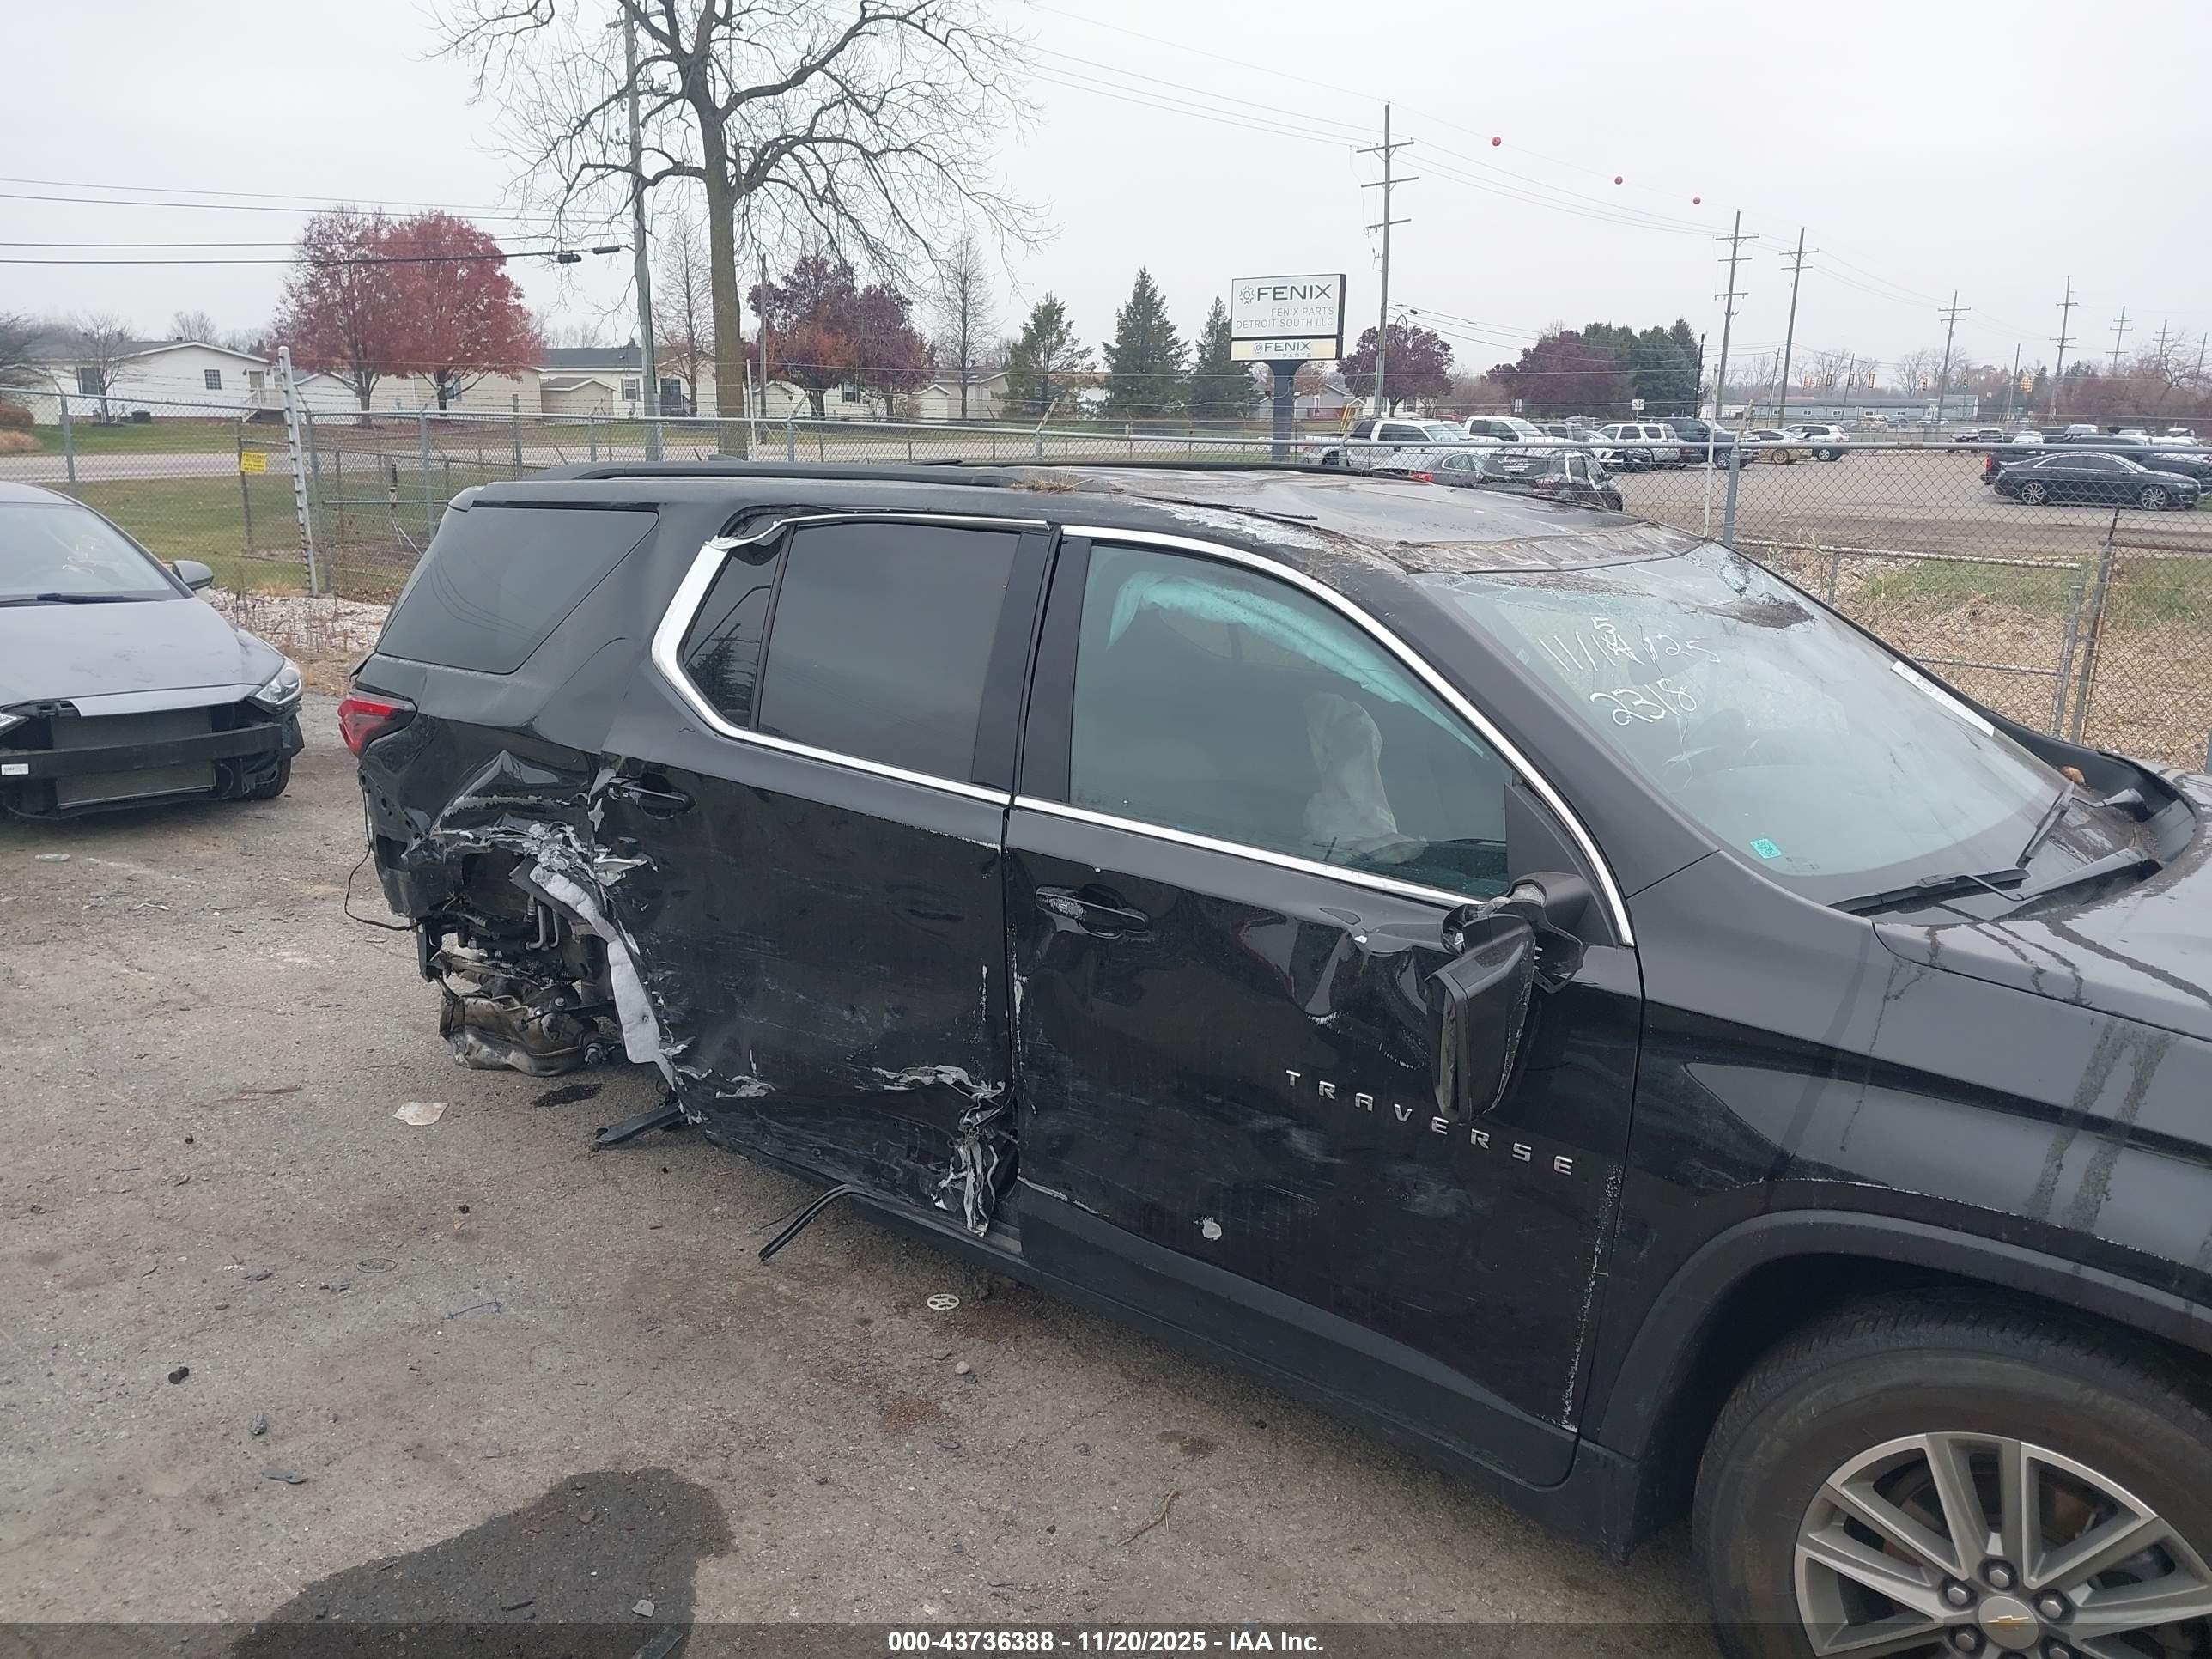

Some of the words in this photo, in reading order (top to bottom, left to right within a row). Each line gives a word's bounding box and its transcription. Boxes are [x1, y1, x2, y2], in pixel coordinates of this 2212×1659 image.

[1256, 283, 1333, 302] FENIX
[1271, 307, 1299, 317] FENIX
[1302, 306, 1334, 316] PARTS
[1236, 319, 1278, 330] DETROIT
[1279, 318, 1313, 328] SOUTH
[1316, 316, 1334, 326] LLC
[1264, 341, 1312, 353] FENIX
[1285, 1069, 1574, 1176] TRAVERSE
